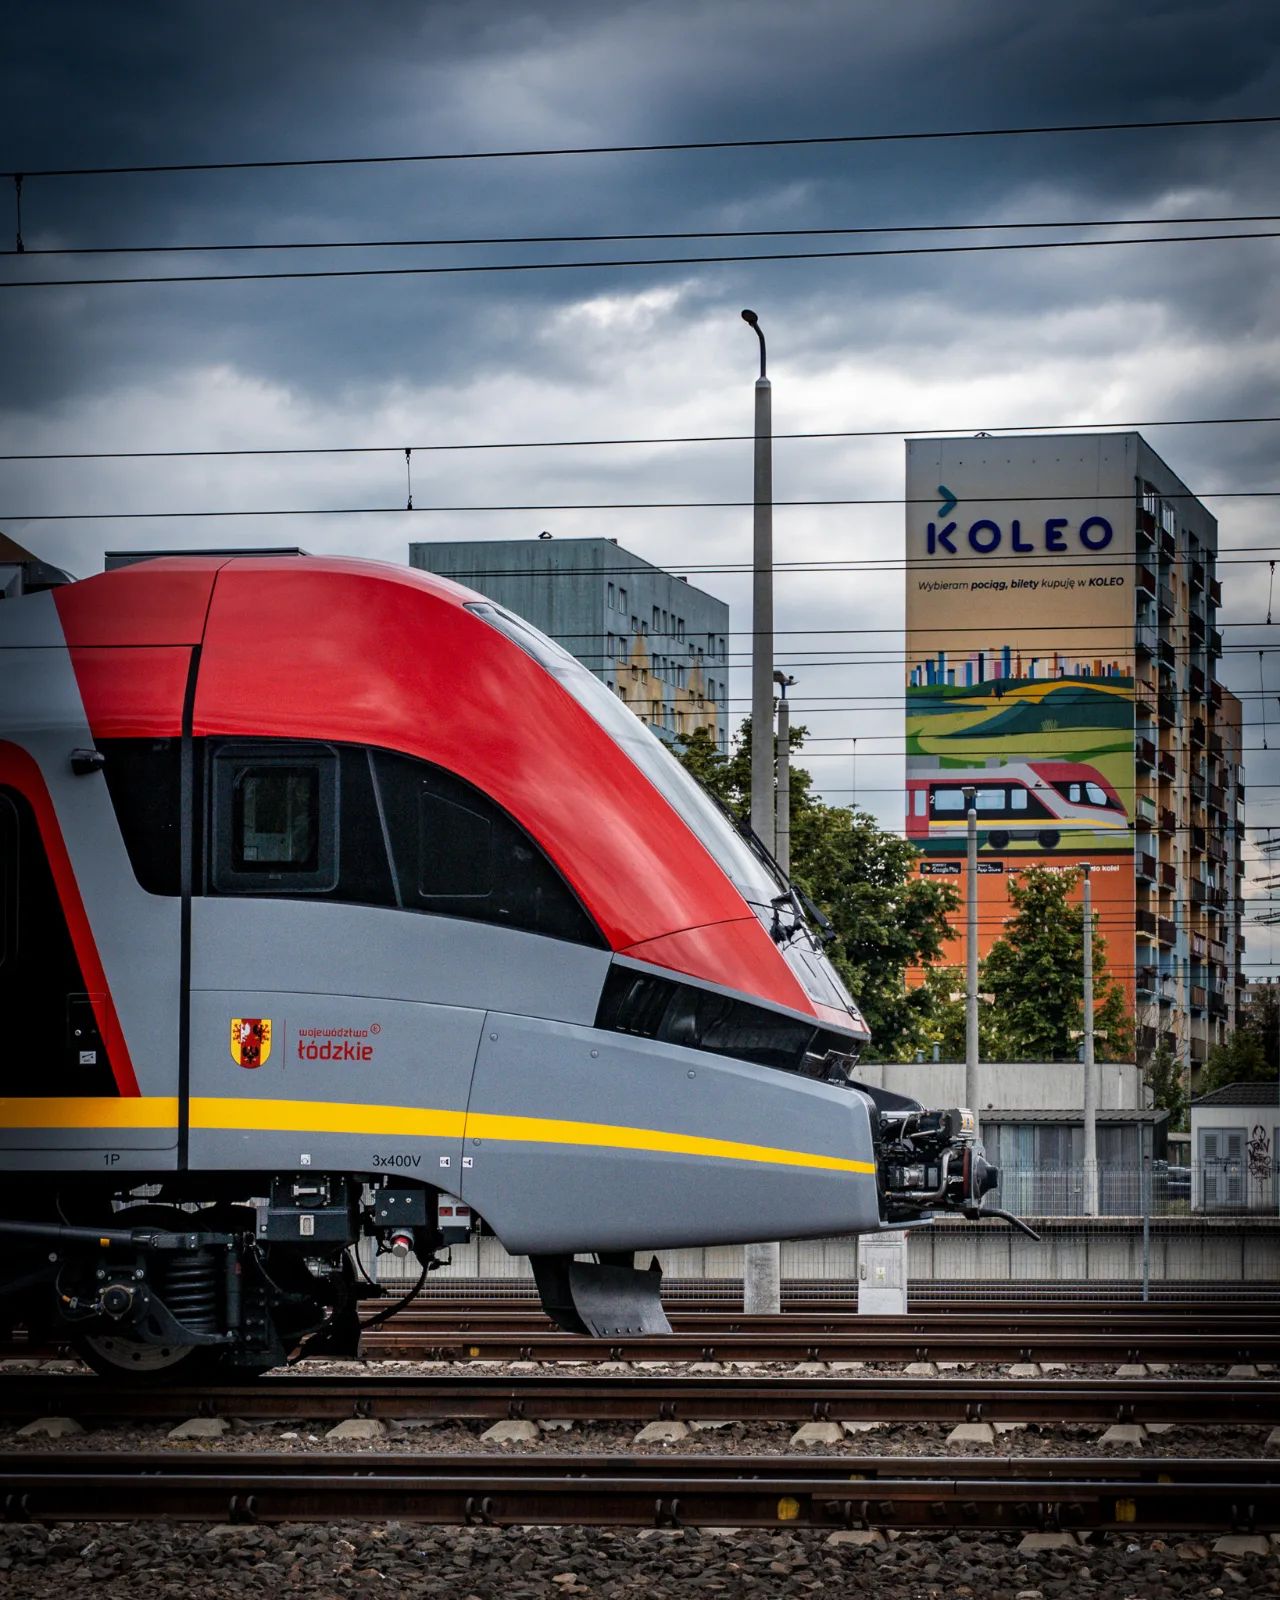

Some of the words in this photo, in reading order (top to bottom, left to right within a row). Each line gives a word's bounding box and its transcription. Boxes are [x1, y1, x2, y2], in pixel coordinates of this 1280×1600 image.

[927, 516, 1113, 555] KOLEO
[918, 580, 968, 592] Wybieram
[971, 579, 1008, 591] pociąg,
[1011, 578, 1038, 590] bilety
[1041, 577, 1075, 590] kupuję
[1078, 579, 1086, 587] w
[1088, 576, 1124, 587] KOLEO
[929, 795, 936, 804] 2
[299, 1027, 368, 1038] województwo
[297, 1039, 374, 1060] łódzkie
[103, 1153, 120, 1166] 1P
[372, 1154, 422, 1167] 3x400V
